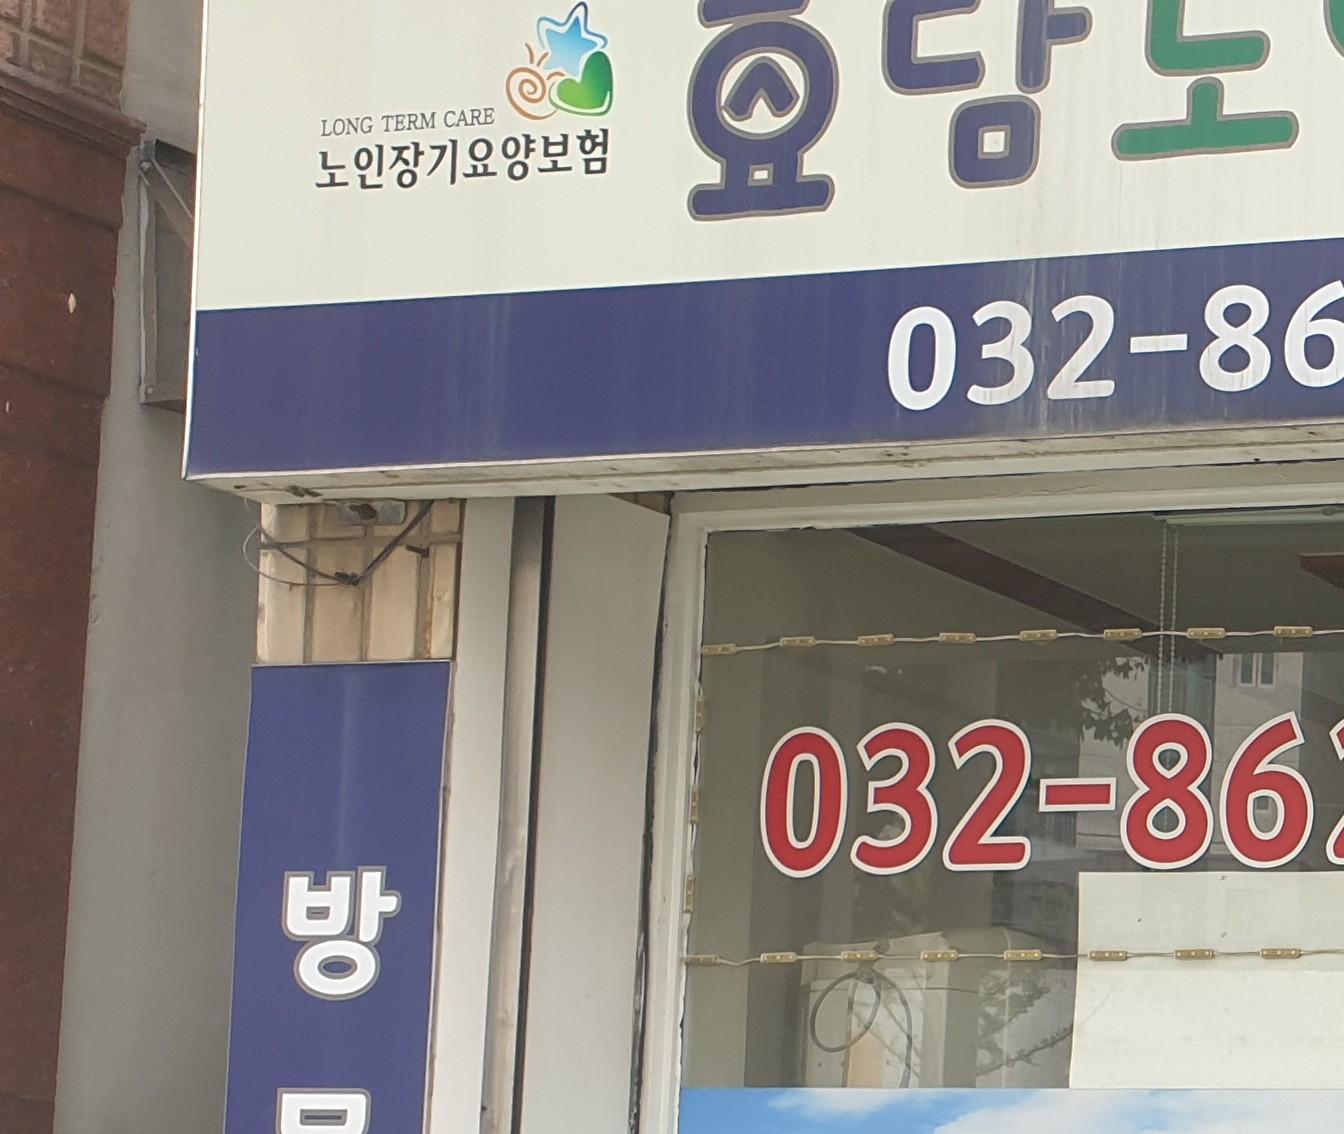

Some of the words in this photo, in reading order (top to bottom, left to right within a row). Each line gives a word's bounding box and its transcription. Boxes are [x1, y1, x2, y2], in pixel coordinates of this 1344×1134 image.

[321, 116, 373, 137] LONG
[381, 112, 437, 133] TERM
[443, 107, 496, 129] CARE
[315, 128, 609, 190] 노인장기요양보험
